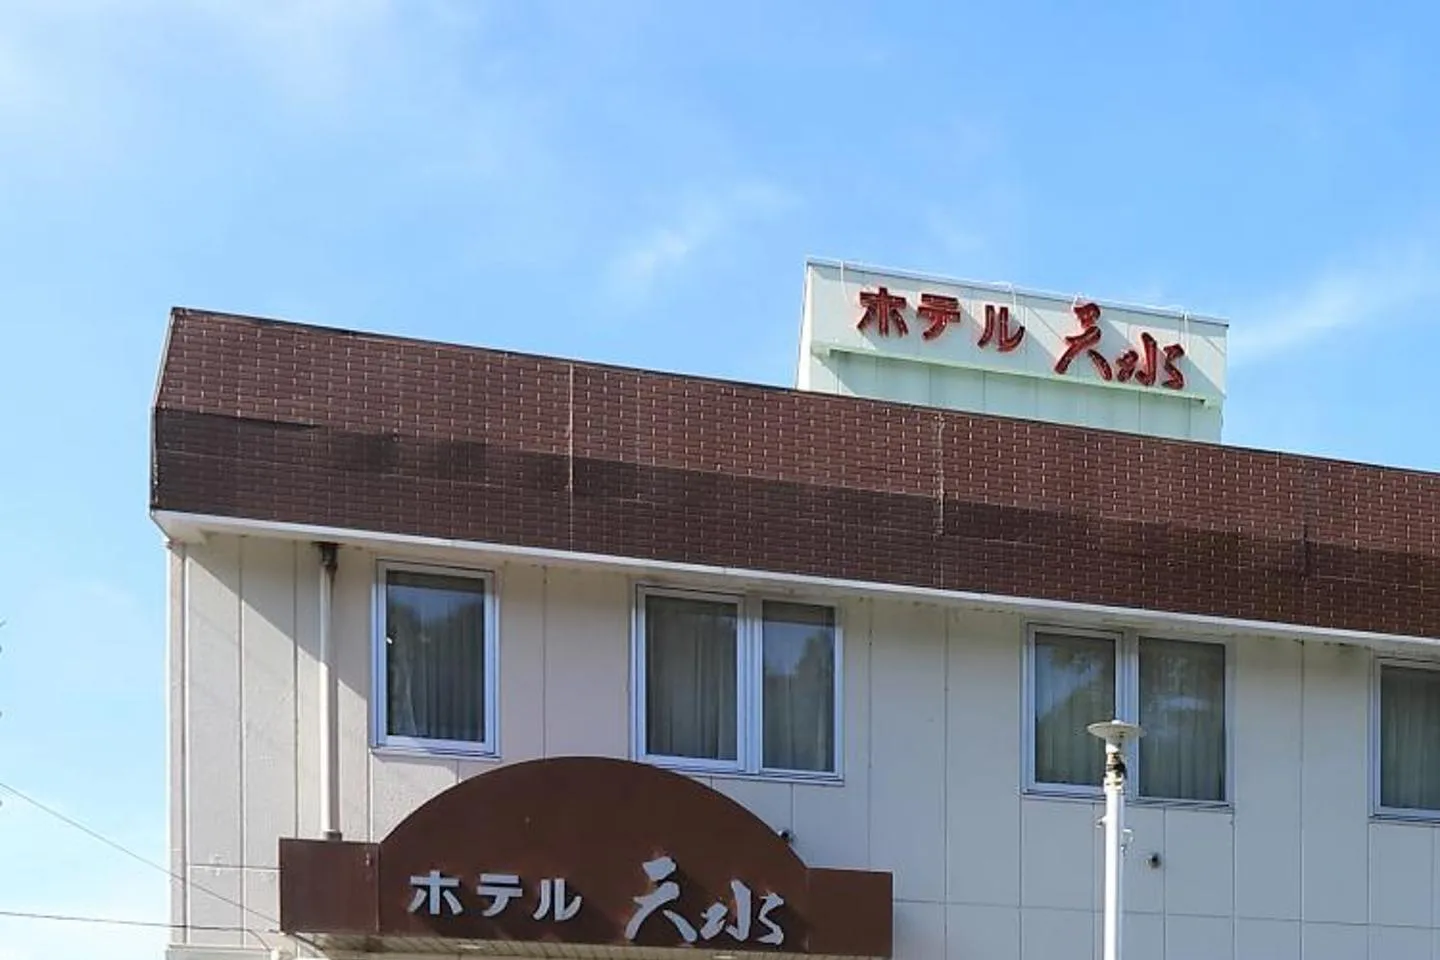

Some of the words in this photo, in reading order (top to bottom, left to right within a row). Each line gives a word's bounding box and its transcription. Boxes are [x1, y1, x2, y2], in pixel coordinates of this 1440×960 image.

[856, 286, 1026, 352] ホテル
[407, 869, 583, 921] ホテル
